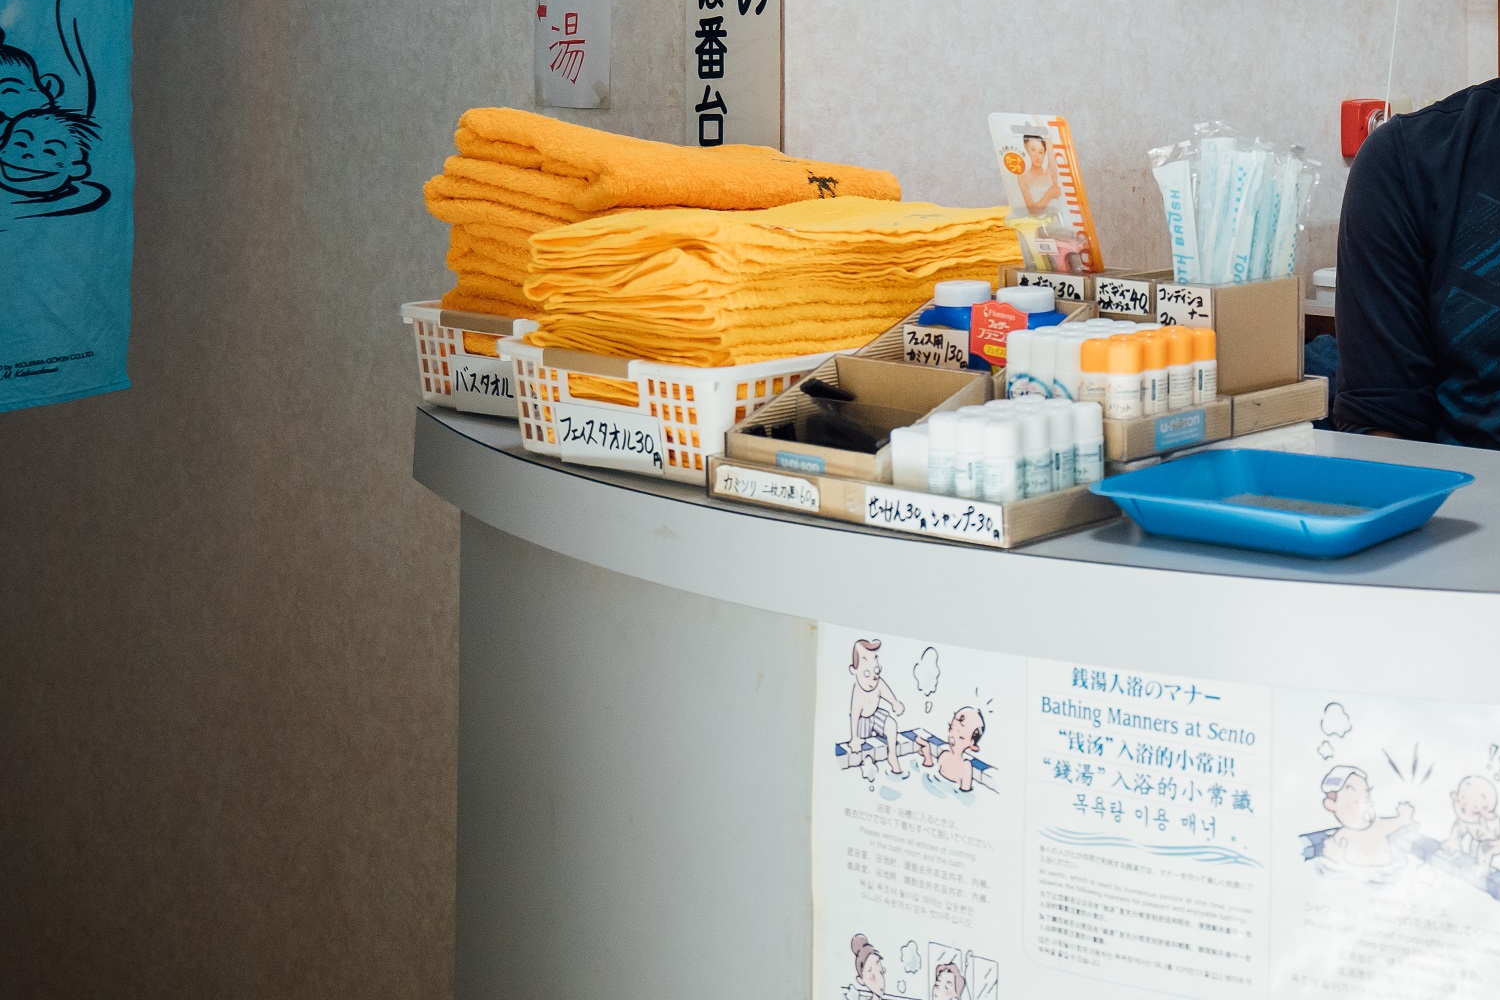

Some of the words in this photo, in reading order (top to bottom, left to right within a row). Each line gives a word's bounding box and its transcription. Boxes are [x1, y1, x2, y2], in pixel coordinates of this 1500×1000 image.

[906, 350, 941, 365] カミソリ
[907, 331, 944, 350] フェイス用
[456, 366, 514, 399] バスタオル
[1072, 667, 1221, 705] 銭湯入浴のマナー
[1041, 696, 1101, 729] Bathing
[1107, 707, 1178, 735] Manners
[1185, 721, 1201, 738] at
[1207, 722, 1256, 746] Sento
[1072, 793, 1125, 823] 목욕탕
[1135, 806, 1169, 832] 이용
[1181, 813, 1216, 839] 매너
